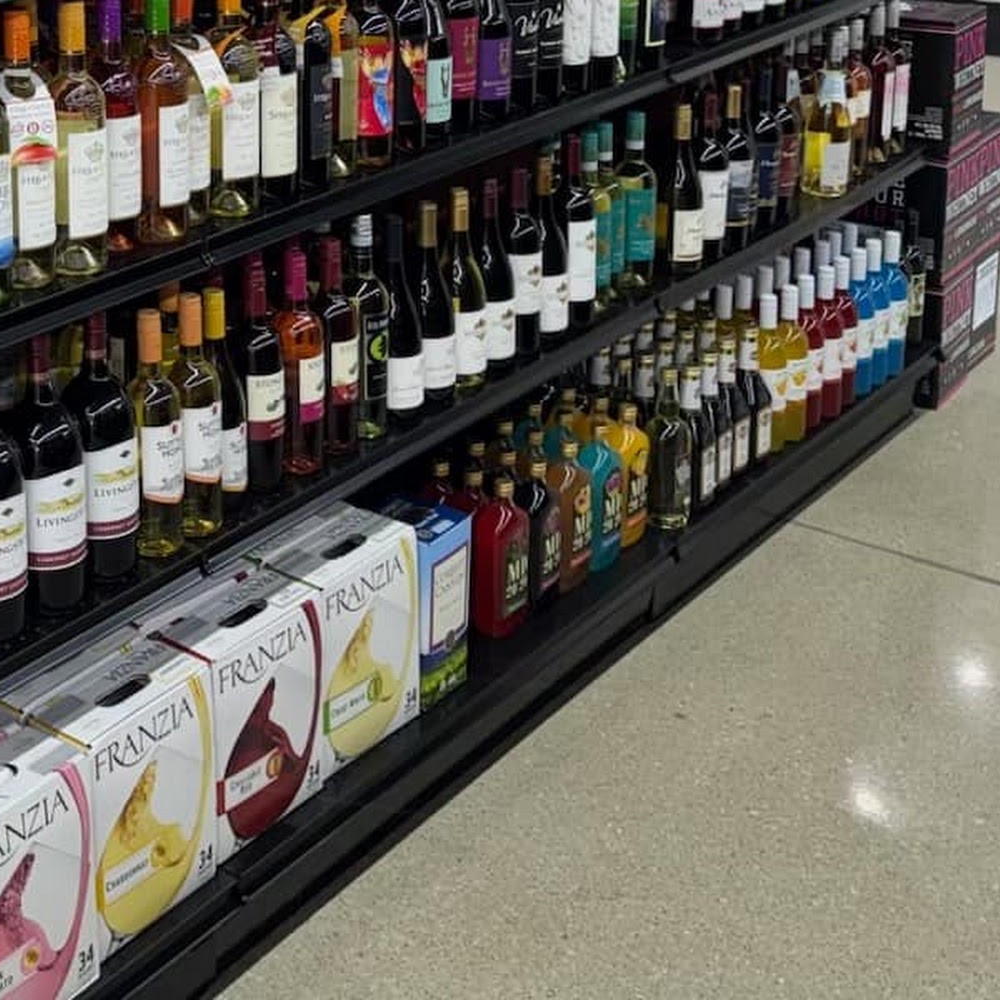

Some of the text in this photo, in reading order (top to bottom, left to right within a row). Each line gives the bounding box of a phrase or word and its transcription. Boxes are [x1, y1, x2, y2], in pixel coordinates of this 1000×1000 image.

[326, 555, 405, 621] FRANZIA
[219, 620, 307, 694] FRANZIA
[94, 697, 194, 782] FRANZIA
[79, 943, 94, 972] 34
